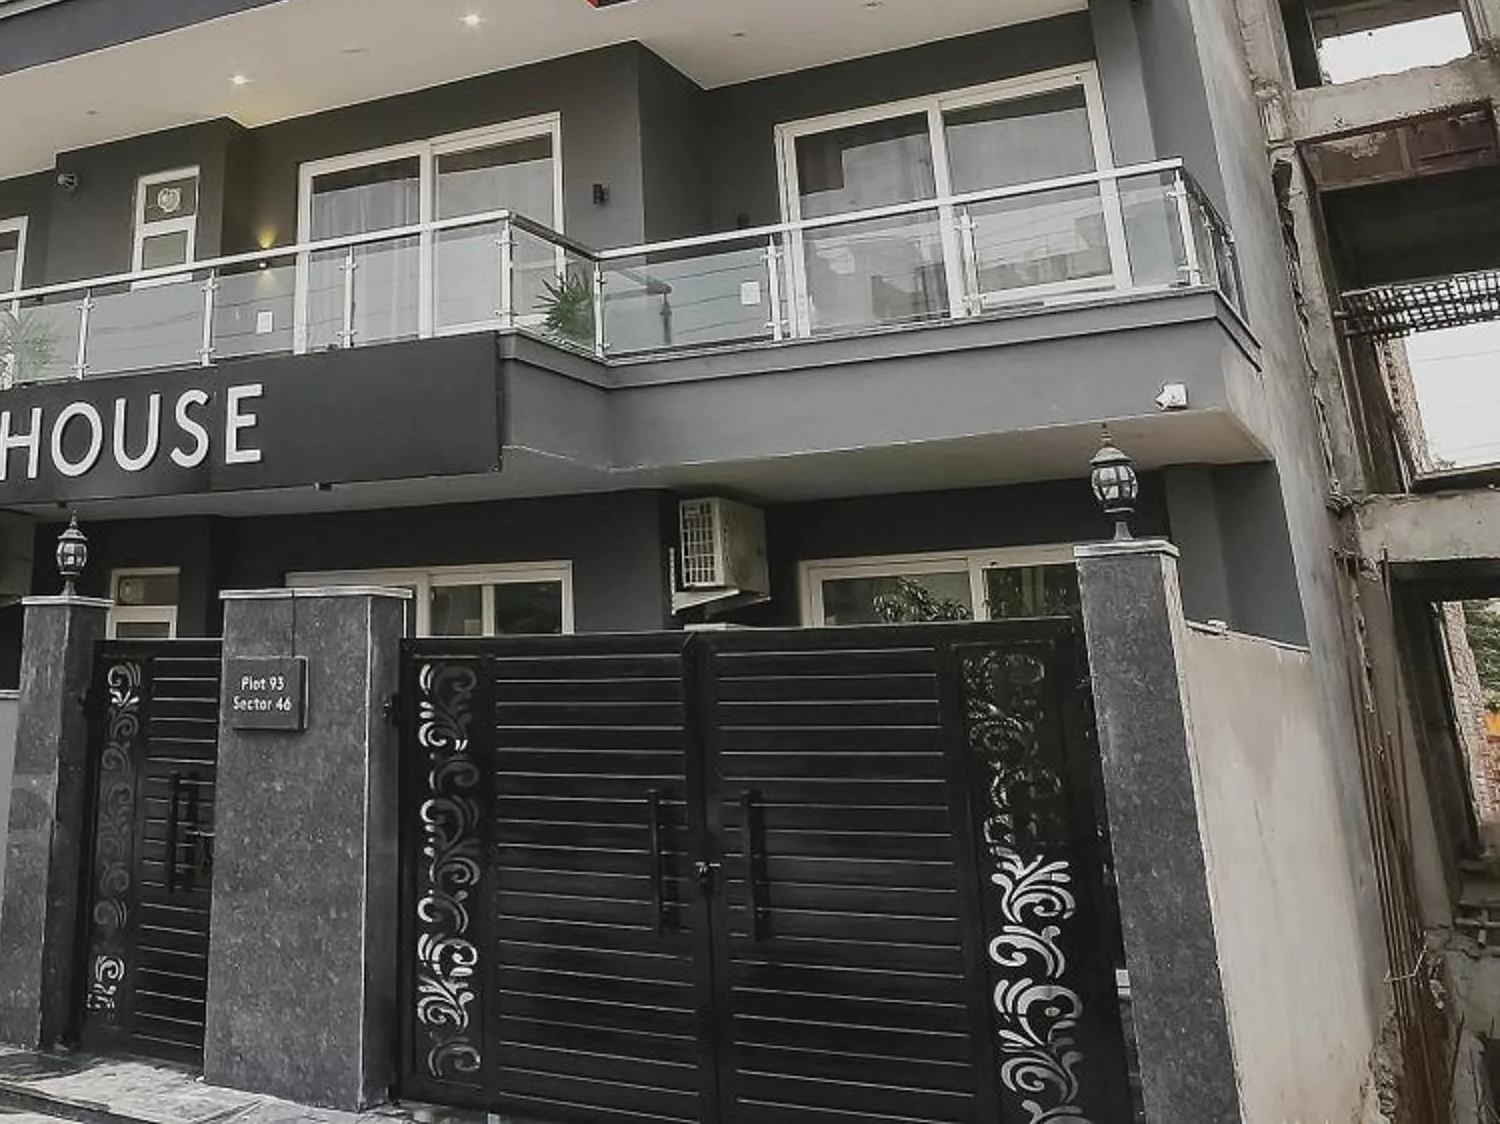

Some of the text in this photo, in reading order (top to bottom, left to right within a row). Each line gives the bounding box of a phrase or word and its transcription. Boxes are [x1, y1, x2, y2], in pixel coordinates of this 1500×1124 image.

[241, 675, 285, 691] Plot 93
[233, 695, 292, 711] Sector 46
